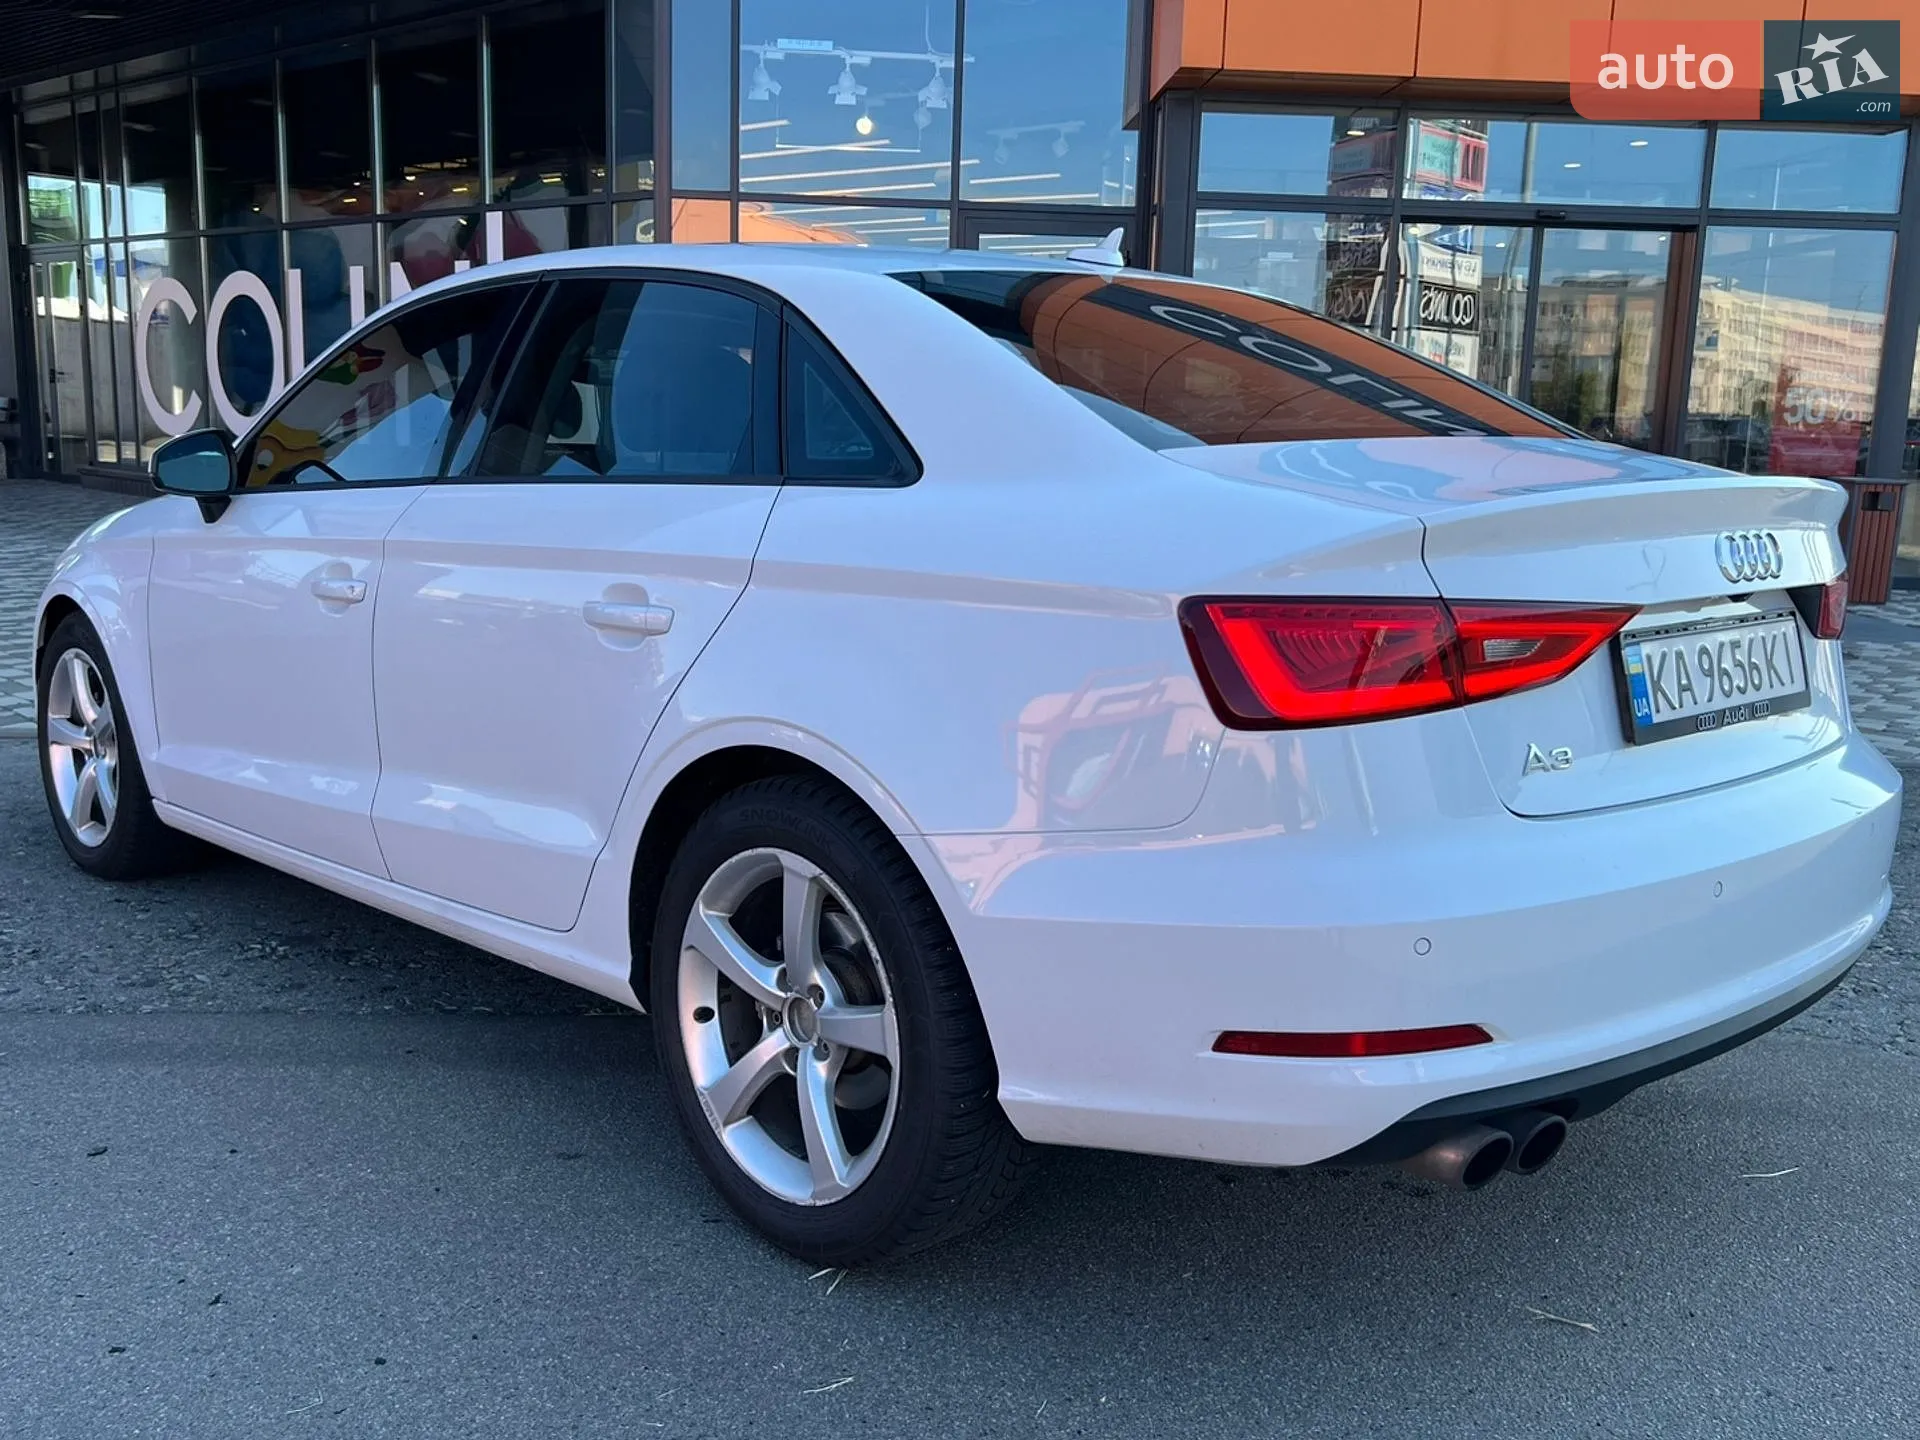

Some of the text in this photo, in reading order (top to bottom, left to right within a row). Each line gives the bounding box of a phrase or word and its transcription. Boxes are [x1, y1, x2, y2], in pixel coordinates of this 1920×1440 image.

[1633, 698, 1651, 717] UA
[1722, 706, 1749, 725] Audi
[1521, 742, 1573, 776] A3
